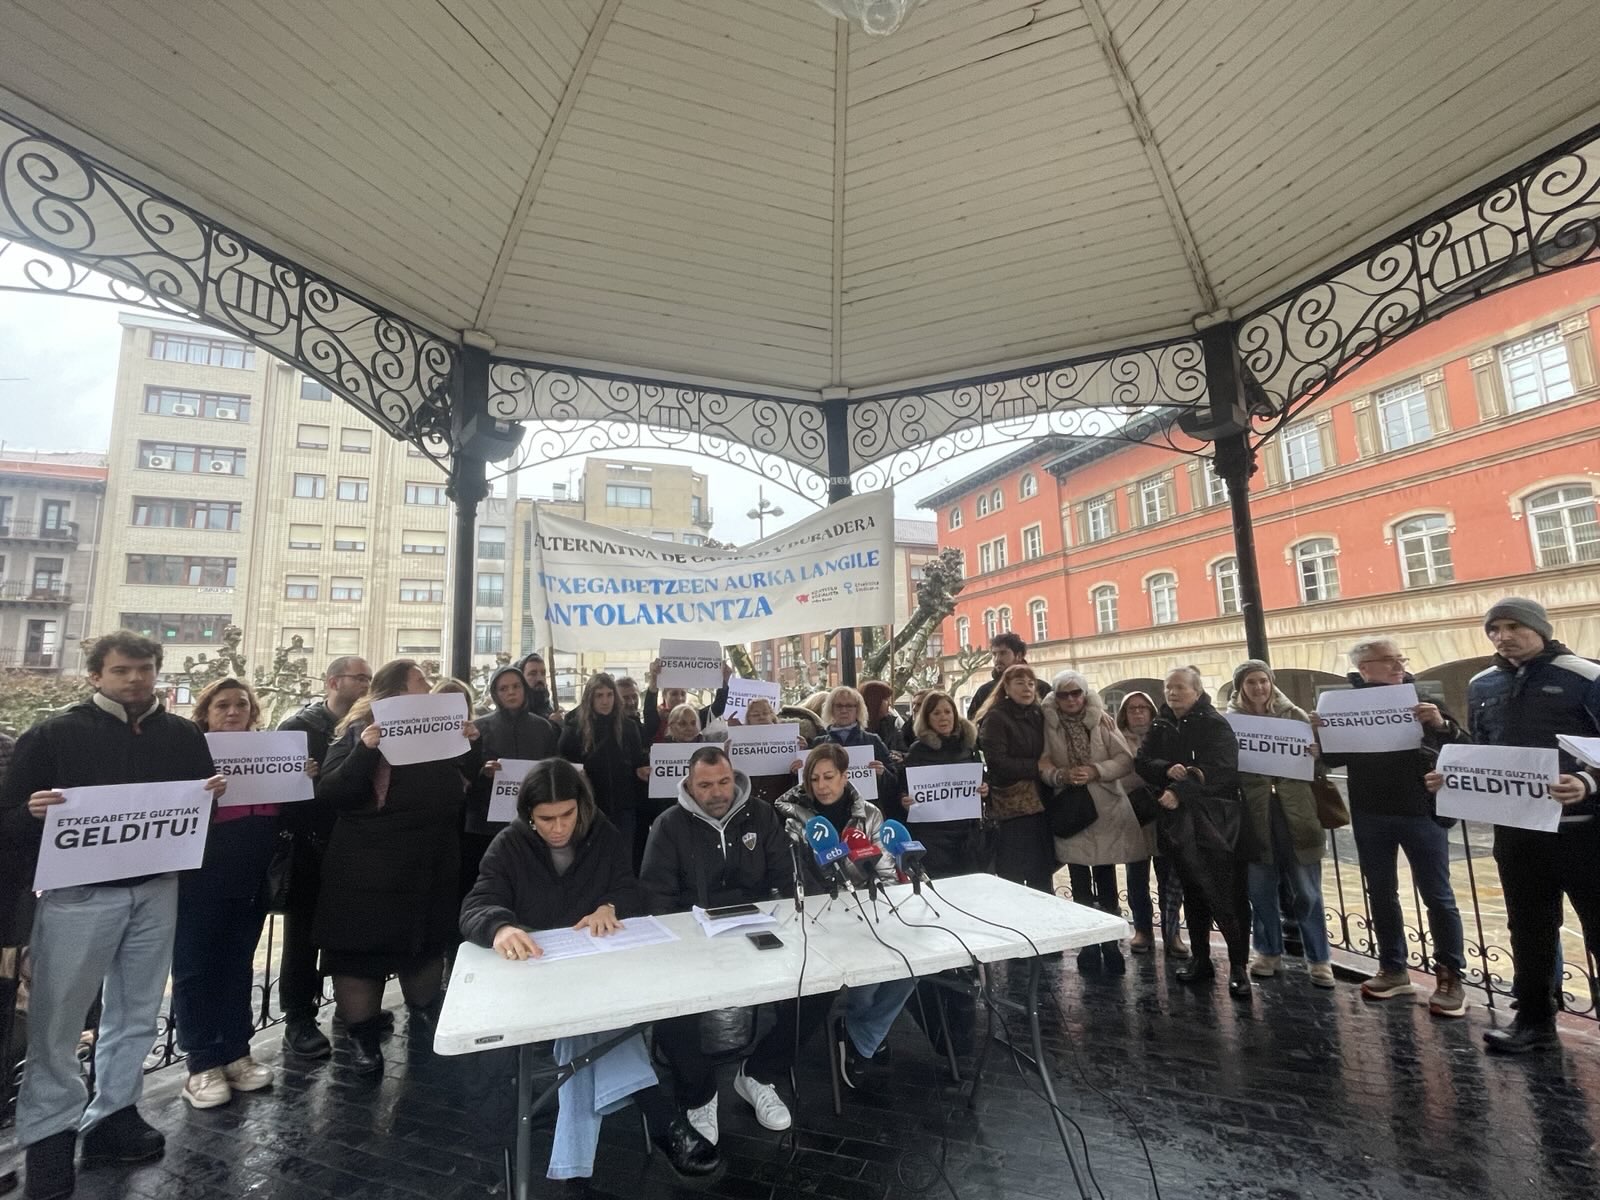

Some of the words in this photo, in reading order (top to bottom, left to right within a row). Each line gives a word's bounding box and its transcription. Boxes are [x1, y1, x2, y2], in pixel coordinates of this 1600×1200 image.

[661, 552, 686, 564] DE
[725, 569, 795, 590] AURKA
[801, 550, 880, 580] LANGILE
[380, 720, 464, 738] DESAHUCIOS!
[732, 745, 797, 755] DESAHUCIOS!
[1239, 738, 1308, 757] ELDITU!
[215, 762, 306, 775] ESAHUCIOS!
[1443, 765, 1502, 776] ETXEGABETZE
[1505, 770, 1549, 780] GUZTIAK
[913, 781, 951, 790] ETXEGABETZE
[1446, 774, 1552, 800] GELDITU!
[914, 786, 976, 803] GELDITU!
[58, 812, 146, 826] ETXEGABETZE
[150, 807, 200, 818] GUZTIAK
[55, 817, 198, 850] GELDITU!
[826, 847, 842, 860] etb
